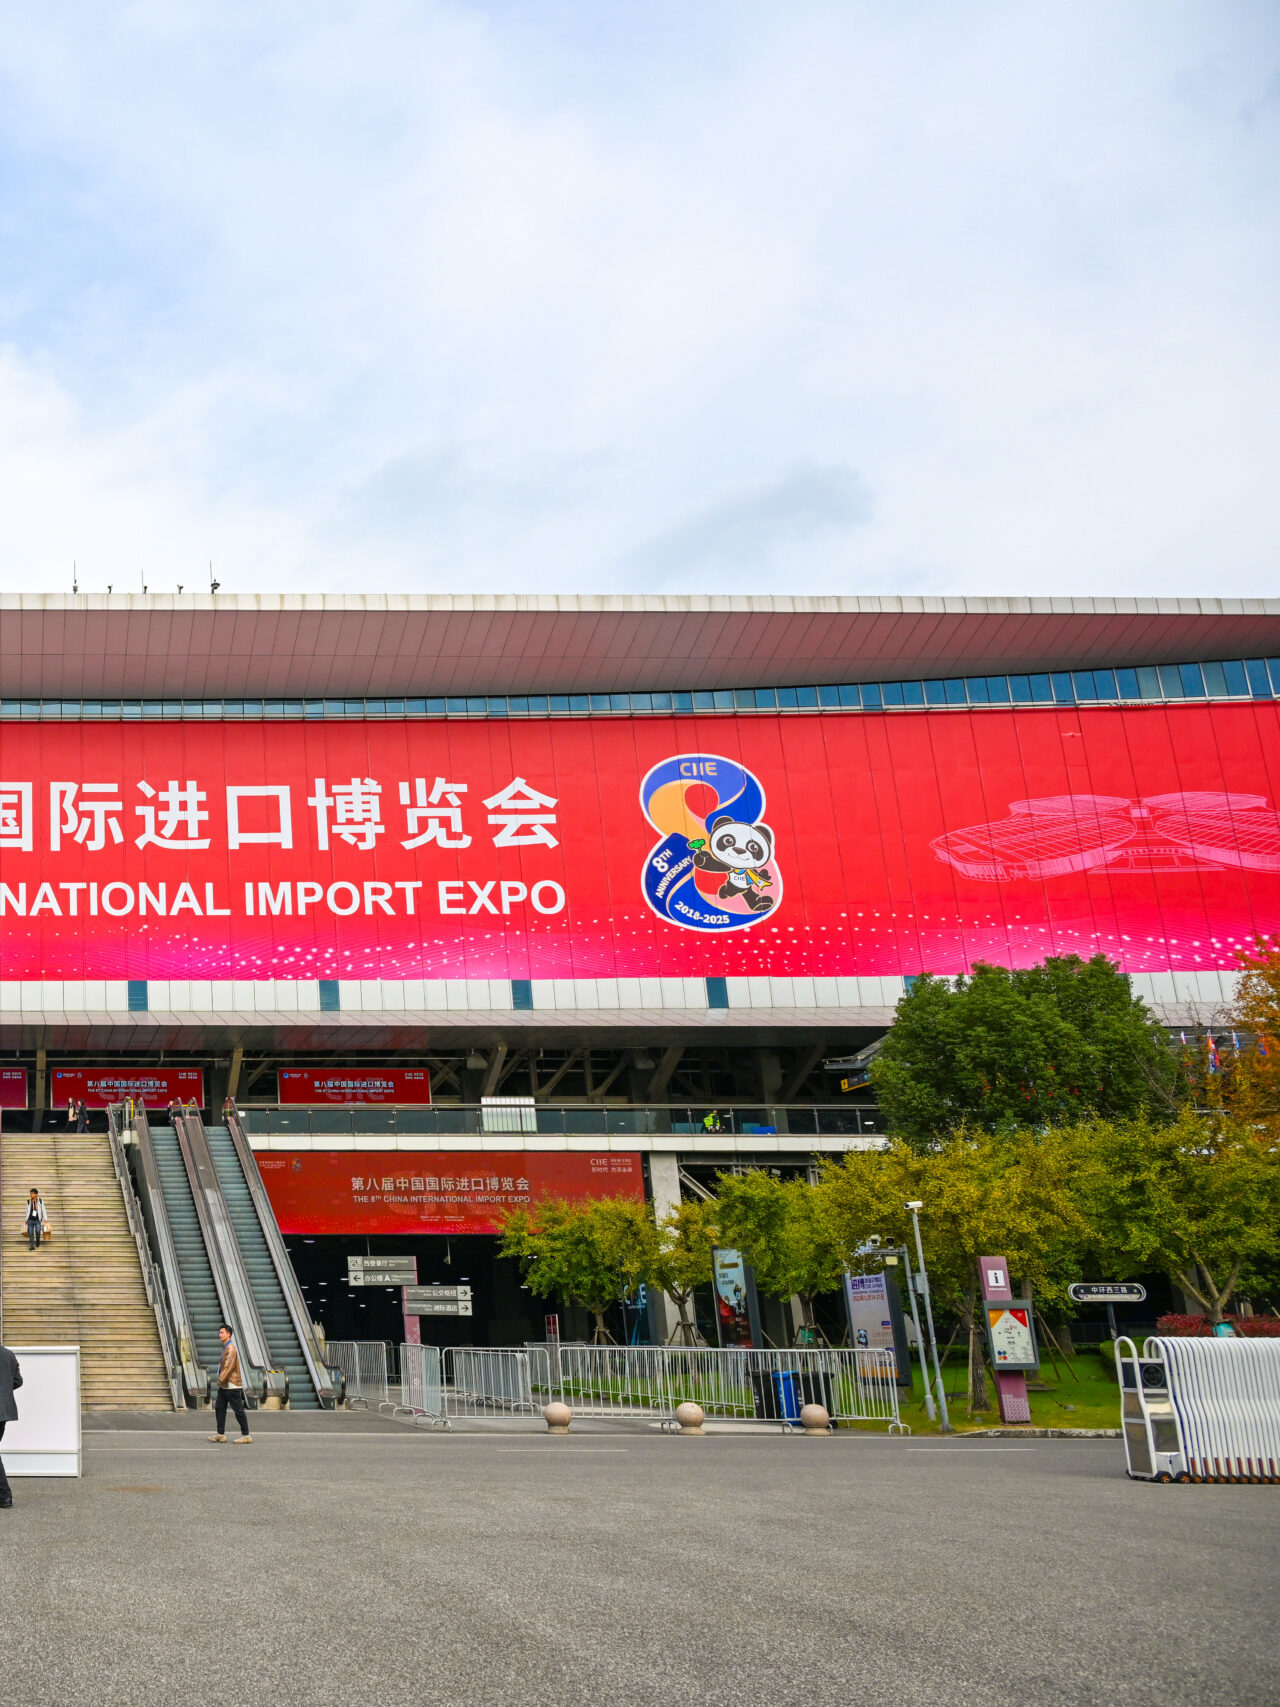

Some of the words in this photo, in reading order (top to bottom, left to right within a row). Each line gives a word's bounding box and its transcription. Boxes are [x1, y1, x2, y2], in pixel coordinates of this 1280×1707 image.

[680, 762, 718, 776] CIIE
[652, 849, 673, 873] 8TH
[655, 855, 693, 899] ANNIVERSARY
[245, 881, 422, 916] IMPORT
[438, 880, 566, 915] EXPO
[674, 901, 730, 924] 2018-2025
[351, 1177, 530, 1191] 第八届中国国际进口博览会
